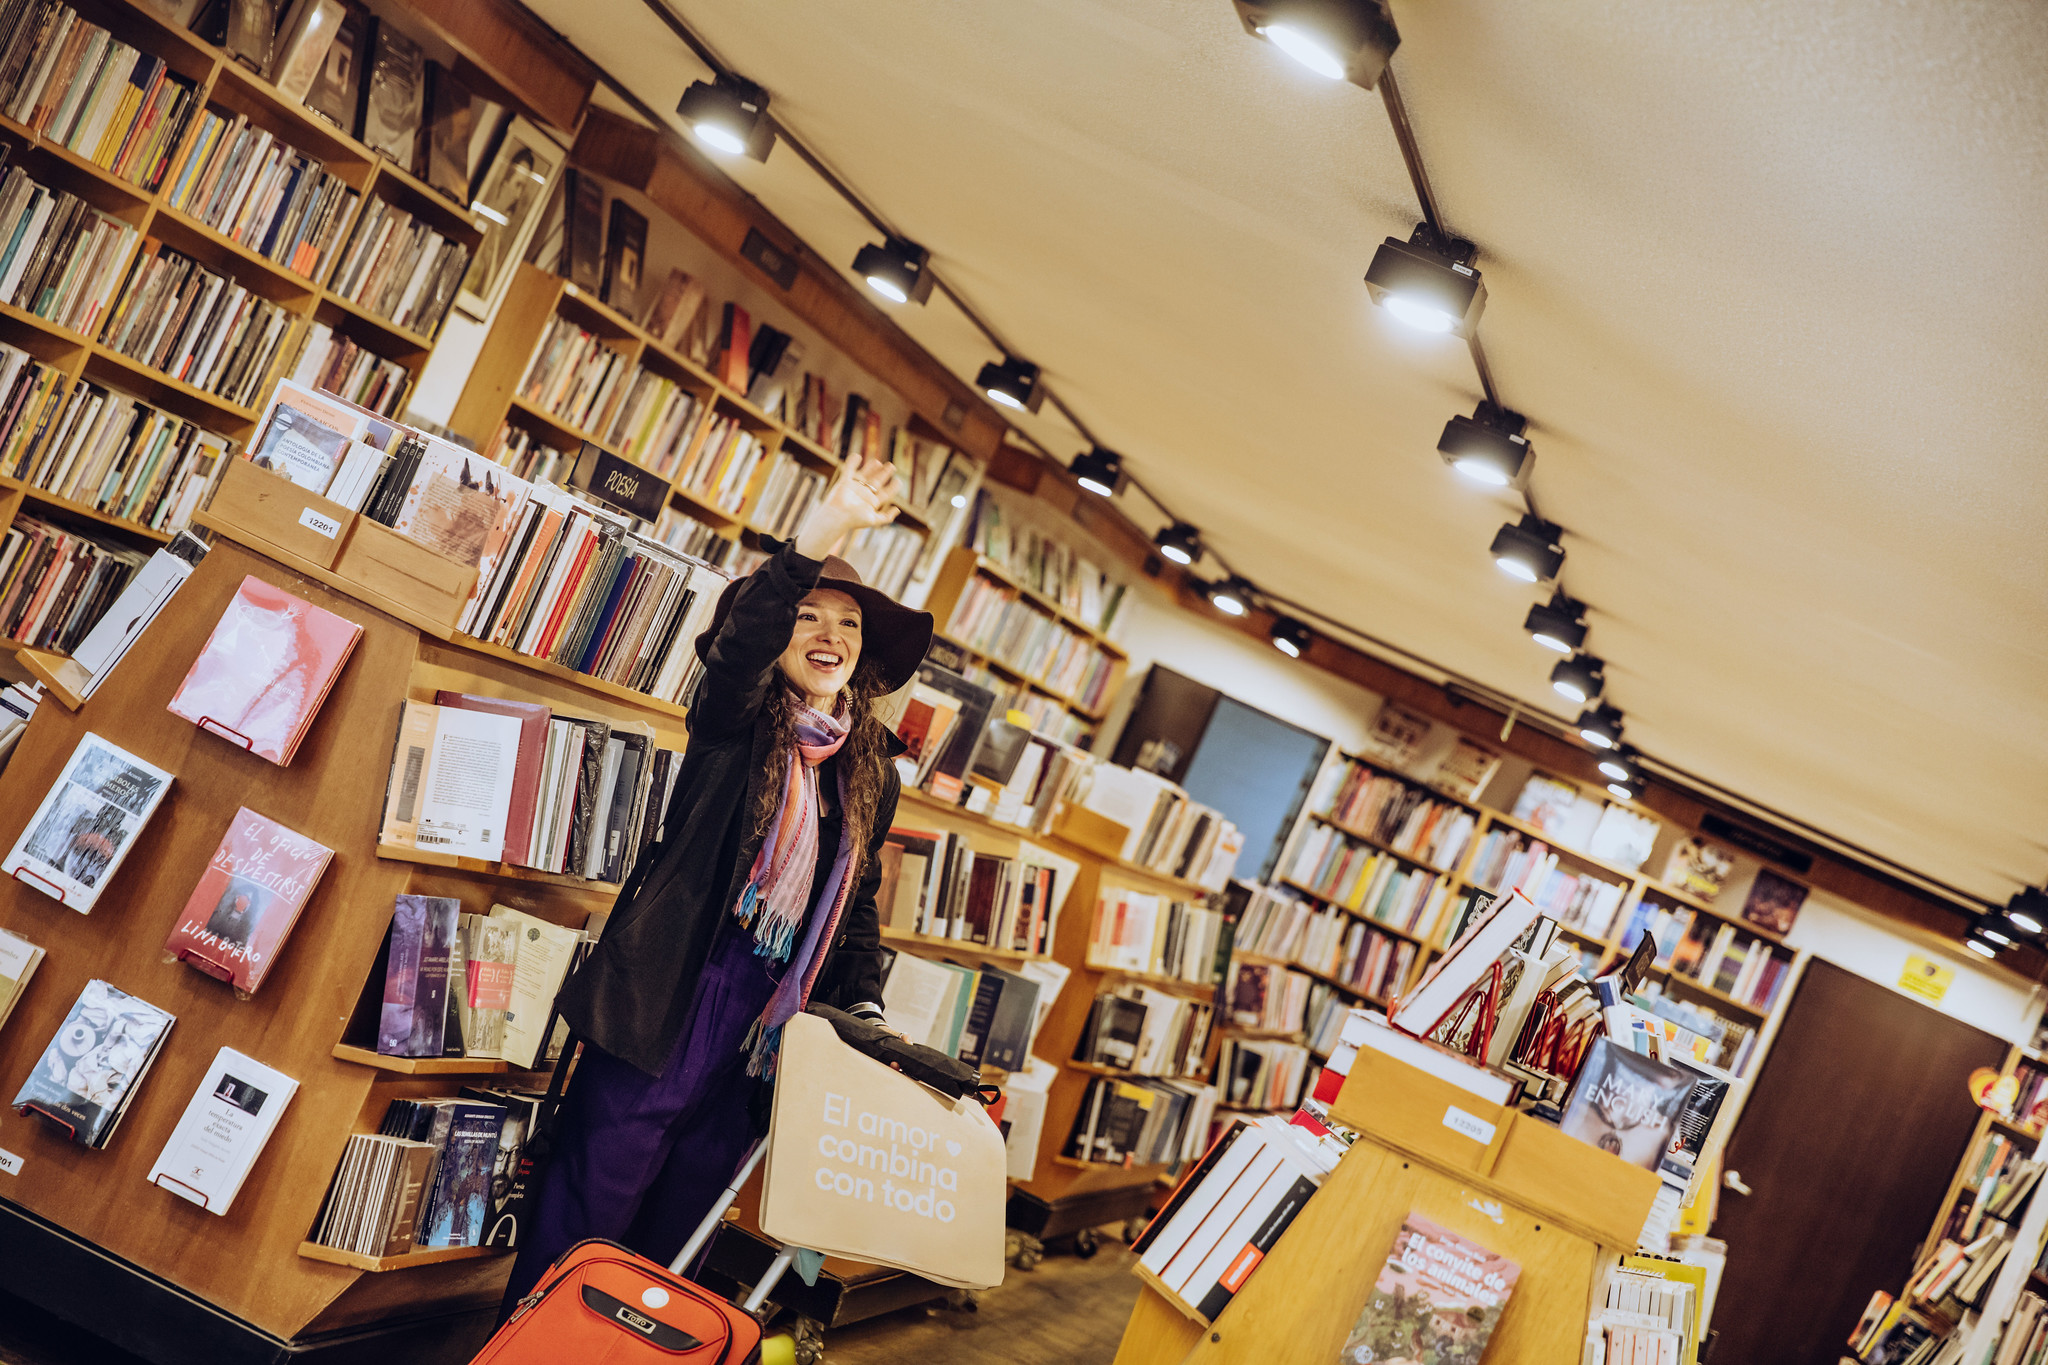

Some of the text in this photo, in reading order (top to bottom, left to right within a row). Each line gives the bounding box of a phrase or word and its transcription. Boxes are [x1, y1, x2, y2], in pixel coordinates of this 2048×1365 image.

[280, 443, 298, 457] POESÍA
[298, 451, 330, 470] COLOMBIANA
[311, 450, 320, 458] DE
[604, 471, 639, 500] POESÍA
[309, 517, 334, 533] 12201
[244, 822, 264, 842] EL
[250, 847, 274, 866] DE
[215, 849, 305, 902] DESVESTIRSE
[218, 936, 262, 963] BOTERO
[208, 1109, 243, 1131] temperatura
[226, 1108, 234, 1118] La
[1584, 1083, 1669, 1132] ENGLISH
[203, 1125, 214, 1135] del
[212, 1121, 231, 1134] exacta
[823, 1091, 941, 1153] El amor
[818, 1133, 958, 1192] combina
[815, 1166, 956, 1223] con todo
[1407, 1232, 1426, 1253] El
[1425, 1245, 1483, 1281] convite
[1484, 1271, 1506, 1292] de
[1401, 1246, 1427, 1270] los
[1427, 1264, 1499, 1307] animales
